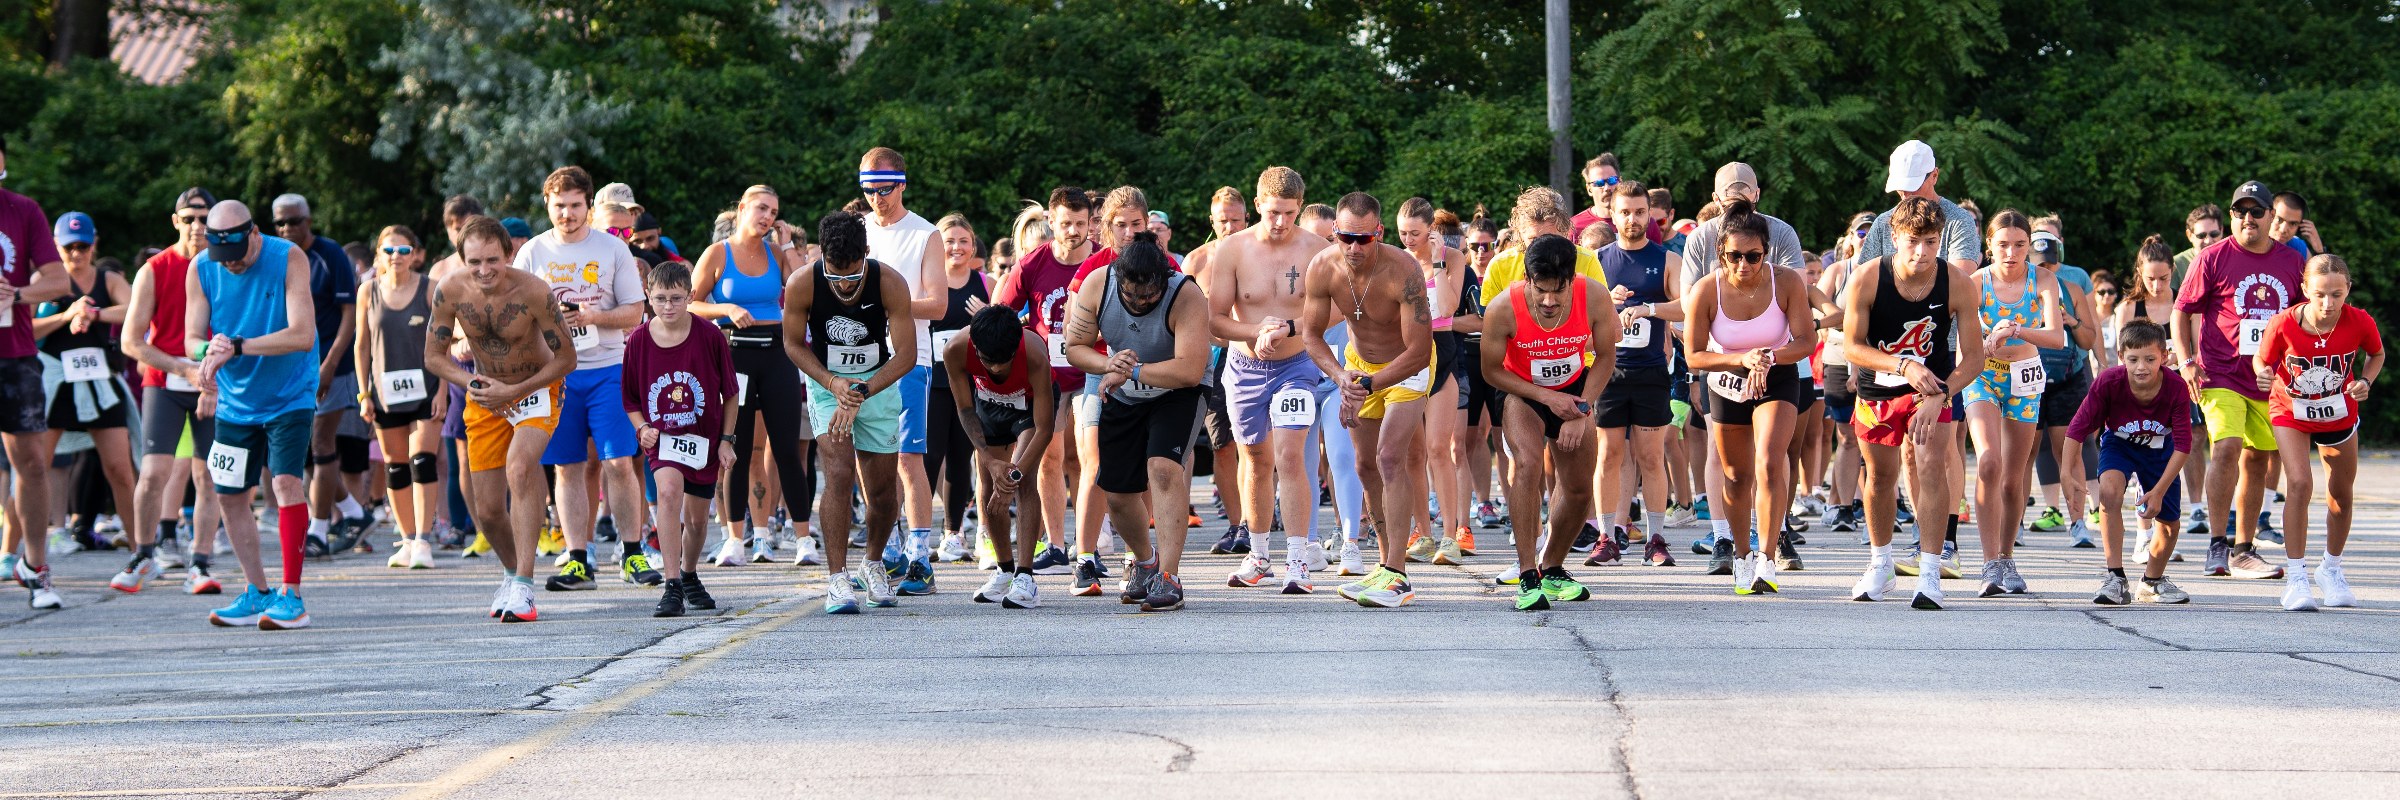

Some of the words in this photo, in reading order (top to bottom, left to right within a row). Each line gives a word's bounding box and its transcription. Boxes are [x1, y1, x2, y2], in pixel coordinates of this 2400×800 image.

[1516, 338, 1544, 349] South
[1546, 333, 1588, 346] Chicago
[840, 352, 866, 365] 776
[1528, 348, 1555, 357] Track
[1556, 345, 1579, 355] Club
[72, 355, 98, 369] 596
[1541, 363, 1572, 378] 593
[2020, 365, 2043, 384] 673
[393, 376, 414, 391] 641
[1718, 373, 1743, 392] 814
[1280, 397, 1306, 413] 691
[2306, 405, 2335, 419] 610
[671, 437, 697, 456] 758
[212, 452, 235, 472] 582
